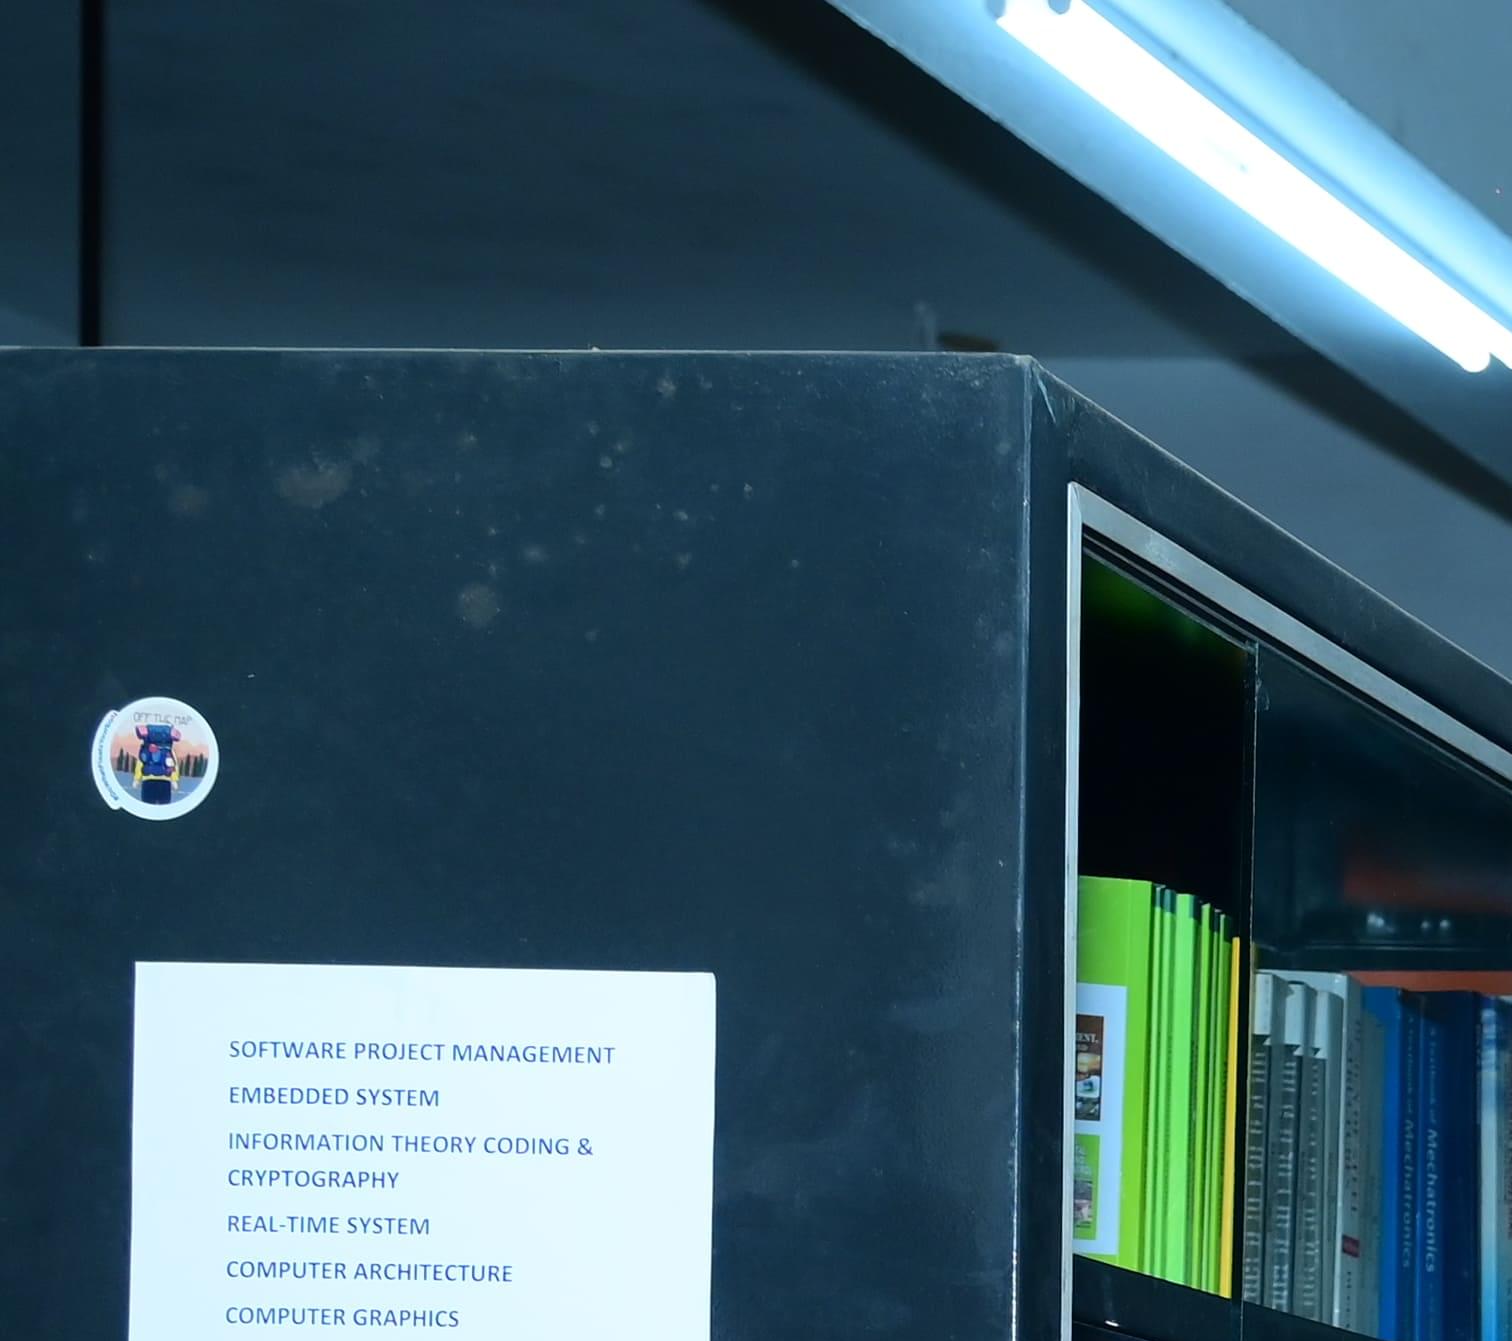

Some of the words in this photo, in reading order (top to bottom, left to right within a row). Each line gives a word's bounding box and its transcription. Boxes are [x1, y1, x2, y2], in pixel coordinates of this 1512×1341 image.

[229, 1040, 347, 1060] SOFTWARE
[354, 1042, 446, 1061] PROJECT
[452, 1044, 616, 1065] MANAGEMENT
[229, 1086, 349, 1105] EMBEDDED
[355, 1088, 439, 1107] SYSTEM
[229, 1132, 384, 1153] INFORMATION
[391, 1135, 477, 1154] THEORY
[483, 1136, 570, 1156] CODING
[577, 1137, 594, 1156] &
[227, 1168, 400, 1189] CRYPTOGRAPHY
[1401, 1119, 1417, 1269] Mechatronics
[1424, 1128, 1439, 1273] Mechatronics
[227, 1215, 340, 1234] REAL-TIME
[346, 1216, 430, 1236] SYSTEM
[226, 1260, 347, 1280] COMPUTER
[353, 1262, 513, 1283] ARCHITECTURE
[225, 1306, 346, 1326] COMPUTER
[352, 1308, 460, 1328] GRAPHICS
